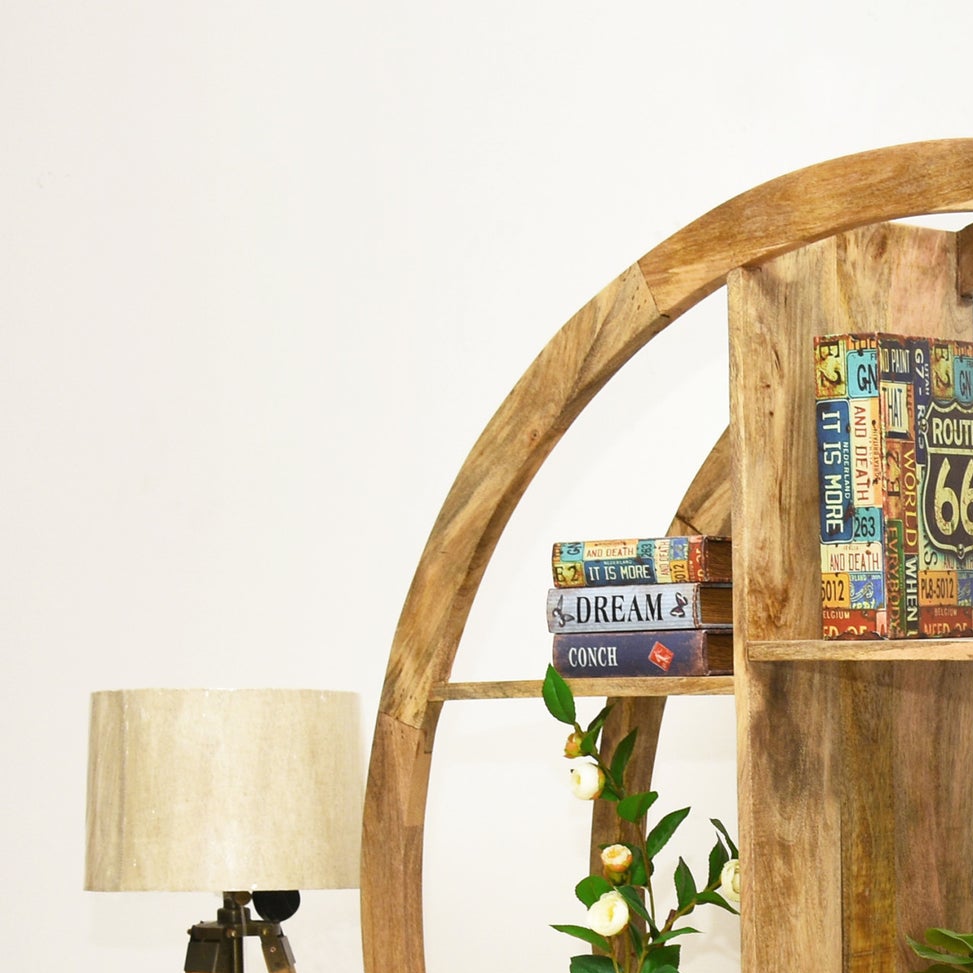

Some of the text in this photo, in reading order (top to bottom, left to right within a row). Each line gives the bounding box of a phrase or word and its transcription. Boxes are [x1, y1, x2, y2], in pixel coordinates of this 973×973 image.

[853, 405, 870, 501] AND DEATH
[822, 410, 844, 533] IT IS MORE
[842, 441, 851, 499] NEDERLAND
[903, 449, 918, 546] WORLD
[854, 516, 876, 538] 263
[586, 546, 634, 558] AND DEATH
[830, 552, 879, 571] AND DEATH
[588, 564, 651, 581] IT IS MORE
[905, 555, 918, 622] WHEN
[920, 578, 954, 599] PL8-5012
[576, 593, 664, 624] DREAM
[568, 646, 618, 668] CONCH
